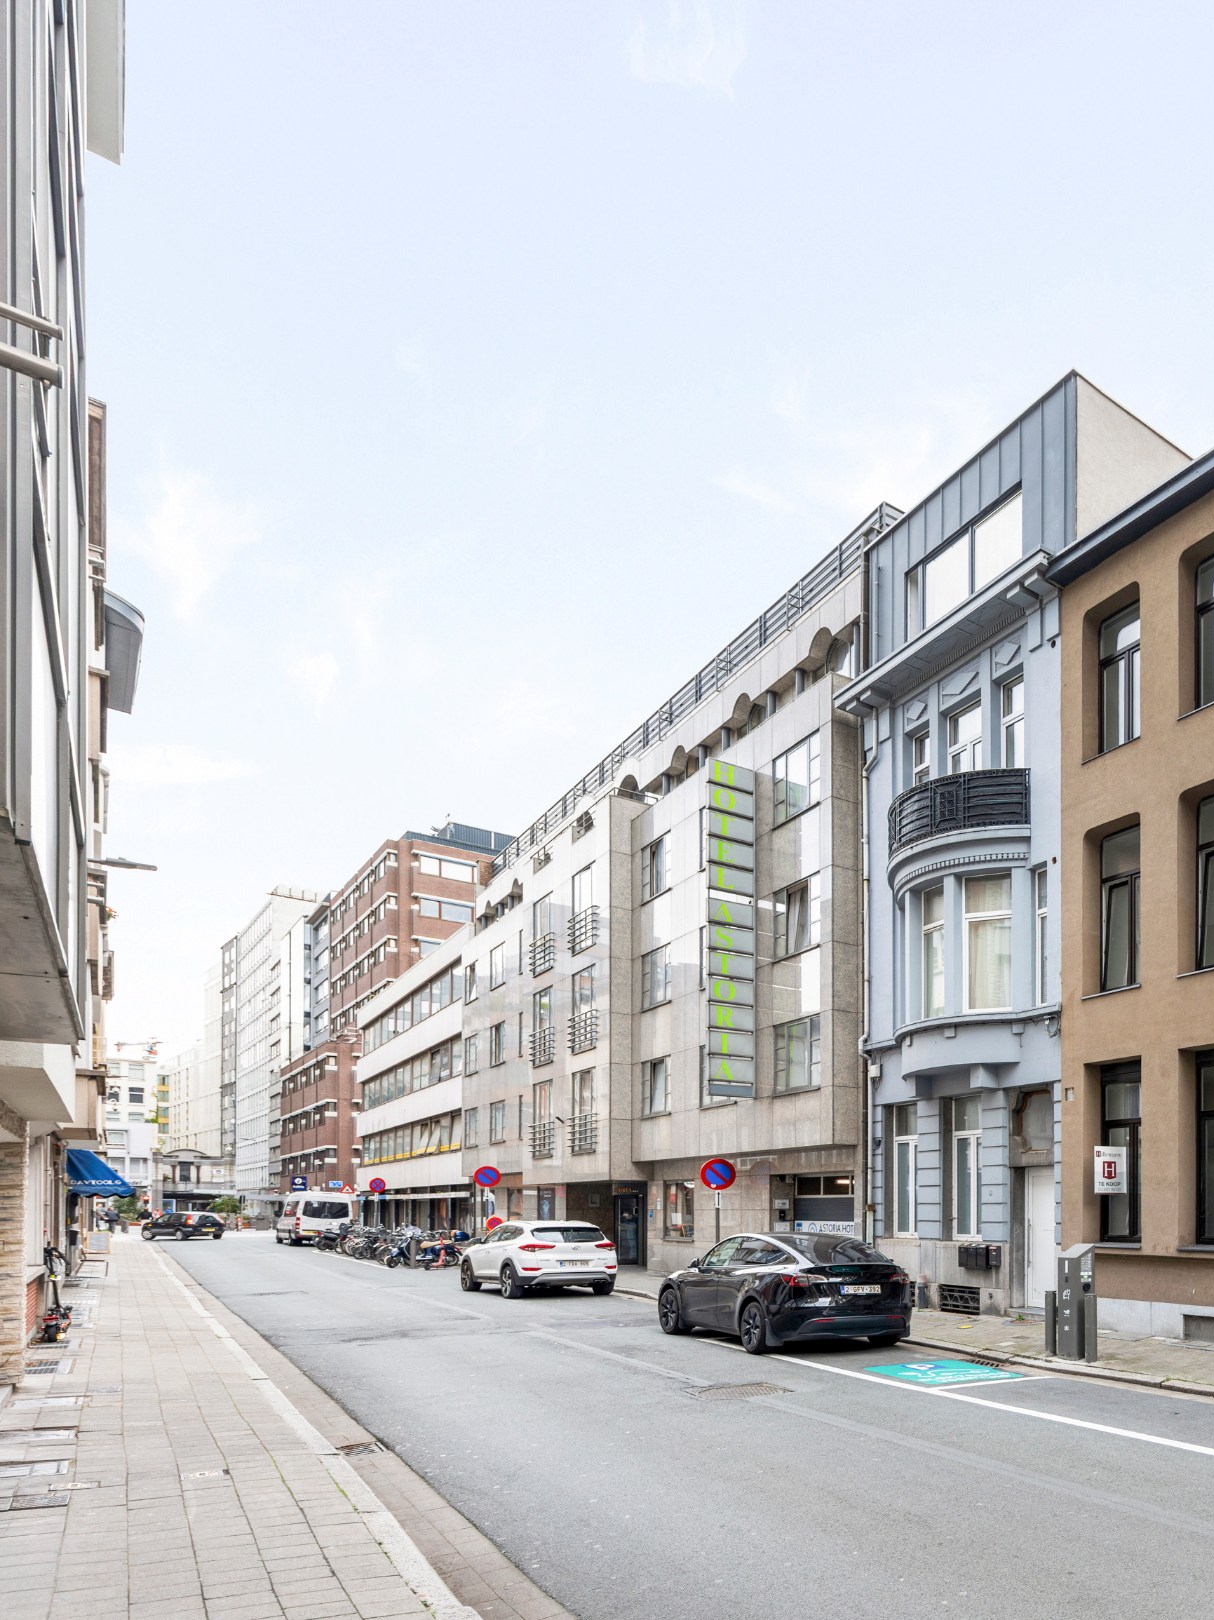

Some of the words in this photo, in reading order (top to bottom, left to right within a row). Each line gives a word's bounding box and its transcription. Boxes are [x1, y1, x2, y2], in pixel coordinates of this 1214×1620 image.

[714, 761, 735, 891] HOTEL
[714, 902, 735, 1081] ASTORIA
[819, 1223, 841, 1233] ASTORIA
